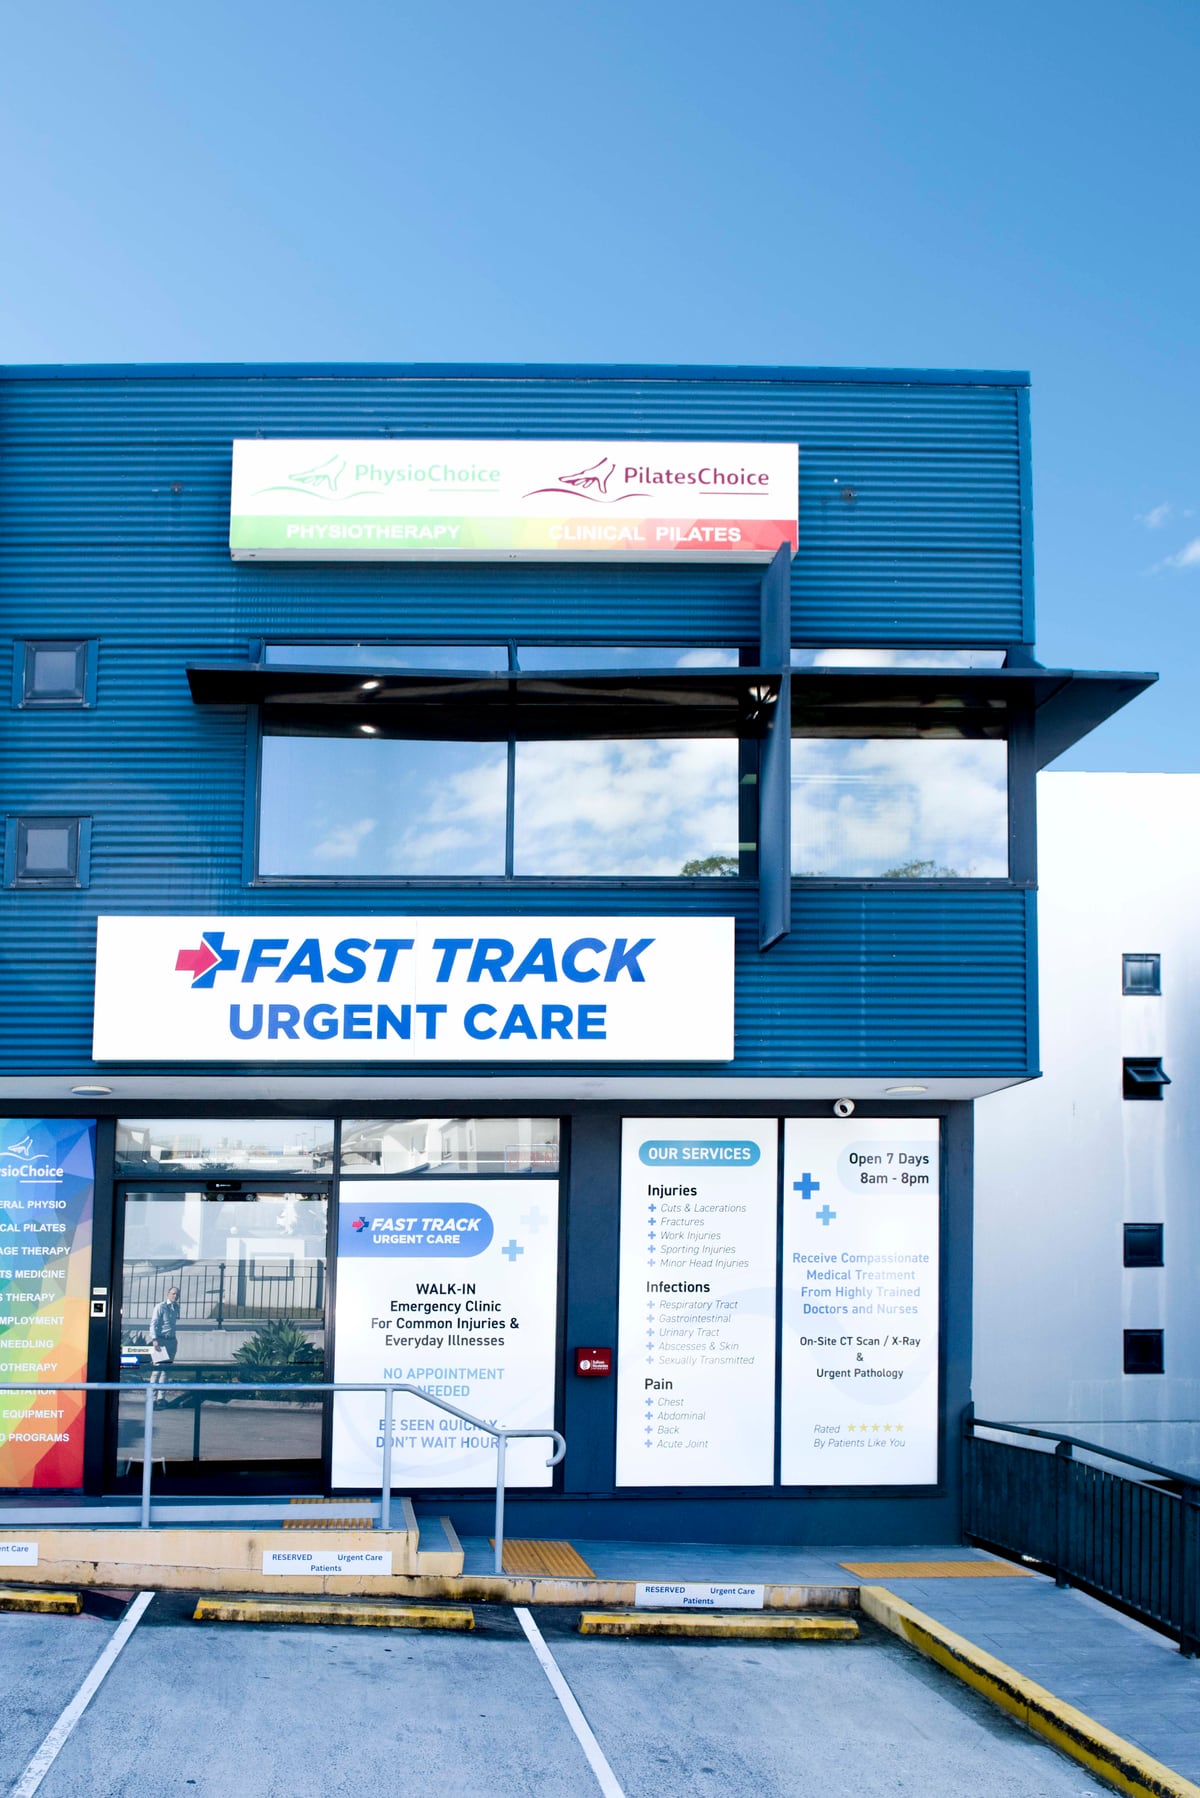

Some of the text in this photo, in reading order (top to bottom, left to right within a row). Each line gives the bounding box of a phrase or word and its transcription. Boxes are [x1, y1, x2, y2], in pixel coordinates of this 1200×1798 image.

[355, 464, 500, 484] PhysioChoice
[624, 466, 769, 487] PilatesChoice
[285, 524, 461, 541] PHYSIOTHERAPY
[548, 526, 741, 542] CLINICAL PILATES
[241, 938, 656, 984] FAST TRACK
[230, 1003, 607, 1040] URGENT CARE
[648, 1147, 751, 1160] OUR SERVICES
[850, 1153, 929, 1166] Open 7 Days
[0, 1165, 64, 1177] sioChoice
[860, 1172, 888, 1184] 8am
[901, 1172, 929, 1186] 8pm
[648, 1184, 698, 1198] Injuries
[27, 1200, 67, 1209] PHYSIO
[660, 1204, 746, 1212] Cuts & Lacerations
[371, 1218, 482, 1231] FAST TRACK
[660, 1217, 704, 1226] Fractures
[0, 1224, 66, 1232] CAL PILATES
[373, 1234, 460, 1244] URGENT CARE
[660, 1231, 721, 1242] Work Injuries
[22, 1246, 71, 1255] THERAPY
[660, 1245, 736, 1255] Sporting Injuries
[660, 1258, 749, 1269] Minor Head Injuries
[792, 1253, 929, 1265] Receive Compassionate
[0, 1270, 66, 1278] TS MEDICINE
[806, 1270, 915, 1280] Medical Treatment
[416, 1284, 476, 1294] WALK-IN
[646, 1281, 710, 1292] Infections
[6, 1293, 55, 1302] THERAPY
[801, 1286, 921, 1299] From Highly Trained
[390, 1300, 501, 1314] Emergency Clinic
[659, 1300, 738, 1311] Respiratory Tract
[803, 1304, 918, 1314] Doctors and Nurses
[659, 1314, 731, 1323] Gastrointestinal
[372, 1318, 520, 1331] For Common Injuries &
[659, 1328, 719, 1338] Urinary Tract
[0, 1340, 54, 1348] NEEDLING
[385, 1334, 505, 1348] Everyday Illnesses
[658, 1342, 739, 1350] Abscesses & Skin
[800, 1336, 921, 1347] On-Site CT Scan / X-Ray
[658, 1356, 754, 1366] Sexually Transmitted
[856, 1352, 864, 1361] &
[0, 1363, 58, 1372] OTHERAPY
[384, 1368, 504, 1379] NO APPOINTMENT
[817, 1369, 903, 1379] Urgent Pathology
[645, 1378, 673, 1390] Pain
[657, 1398, 684, 1406] Chest
[2, 1410, 64, 1418] EQUIPMENT
[657, 1412, 706, 1420] Abdominal
[400, 1419, 434, 1430] SEEN
[439, 1419, 498, 1430] QUICY
[657, 1425, 680, 1434] Back
[814, 1424, 840, 1434] Rated
[8, 1434, 70, 1442] PROGRAMS
[421, 1436, 458, 1448] WAIT
[657, 1439, 708, 1448] Acute Joint
[814, 1438, 905, 1449] By Patients Like You
[337, 1554, 363, 1562] Urgent
[710, 1587, 736, 1596] Urgent
